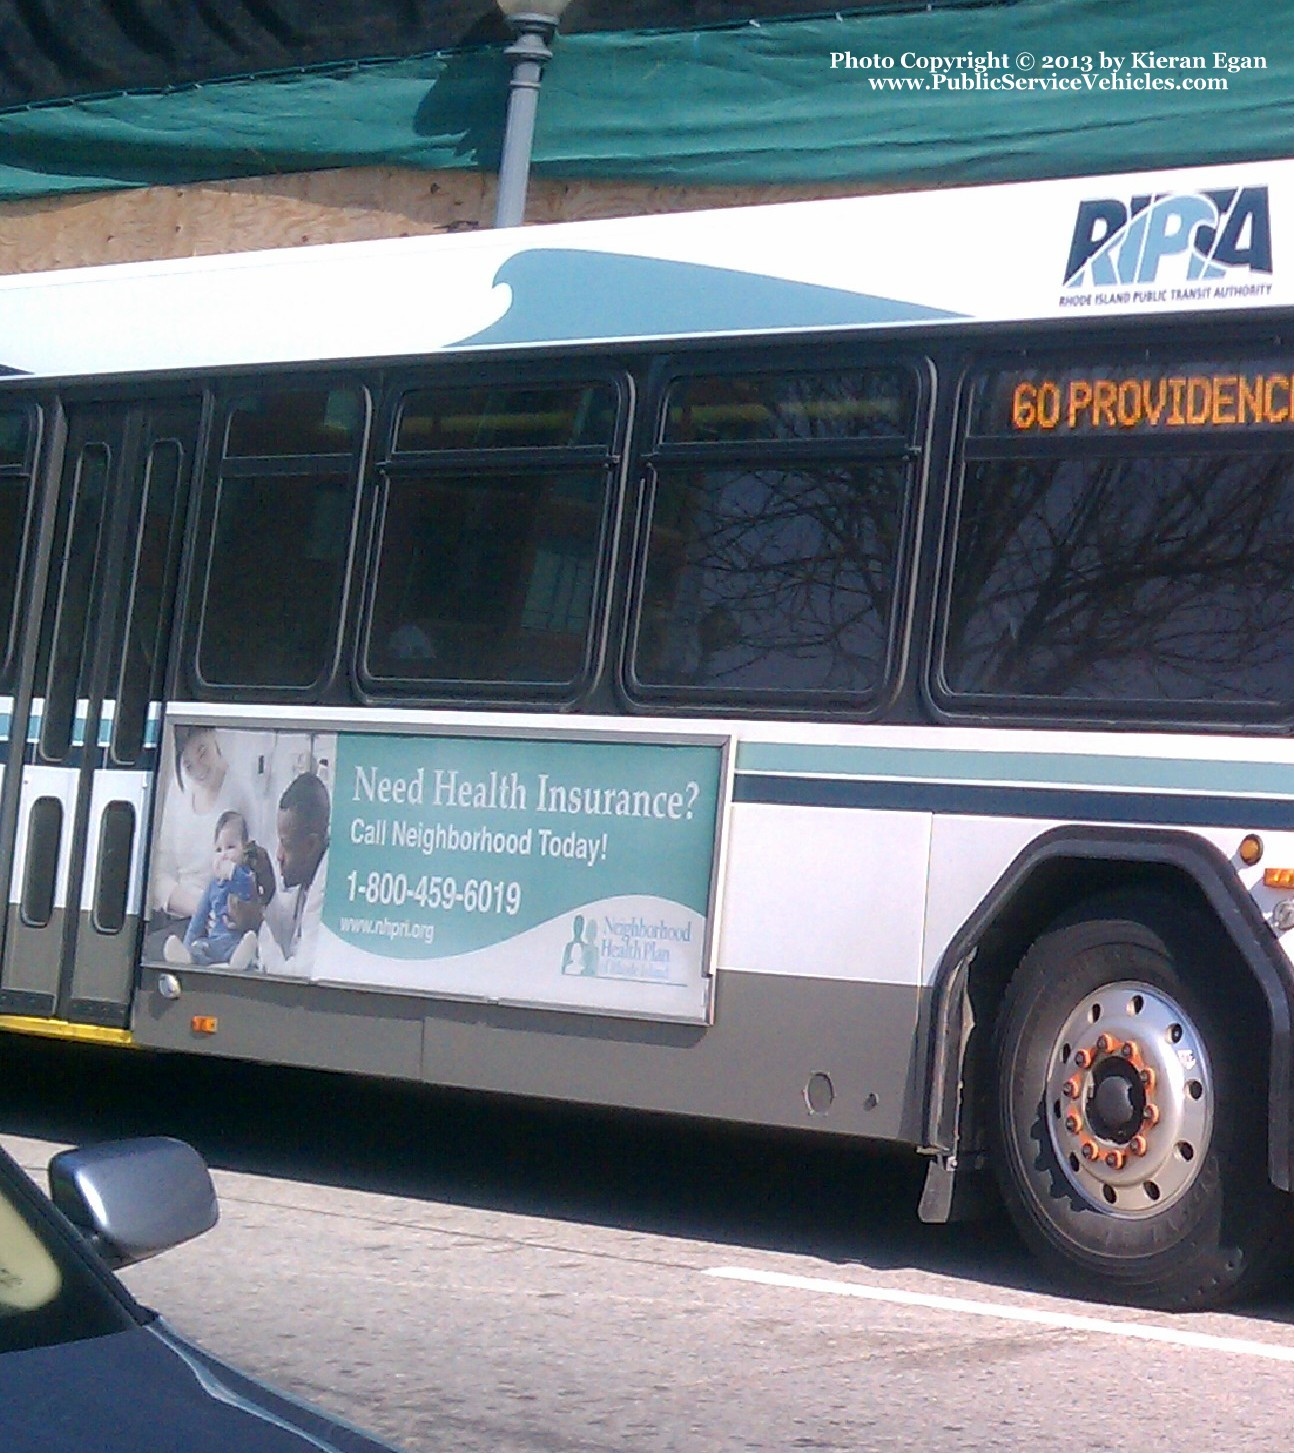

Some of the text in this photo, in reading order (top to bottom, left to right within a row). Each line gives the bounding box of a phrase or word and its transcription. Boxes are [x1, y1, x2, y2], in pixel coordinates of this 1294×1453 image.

[1062, 185, 1273, 288] RIPTA
[1059, 283, 1273, 307] RHODE ISLAND PUBLIC TRANSIT AUTHORITY
[352, 766, 701, 820] Need Health Insurance?
[350, 818, 608, 867] Call Neighborhood Today!
[348, 869, 521, 916] 1-800-459-6019
